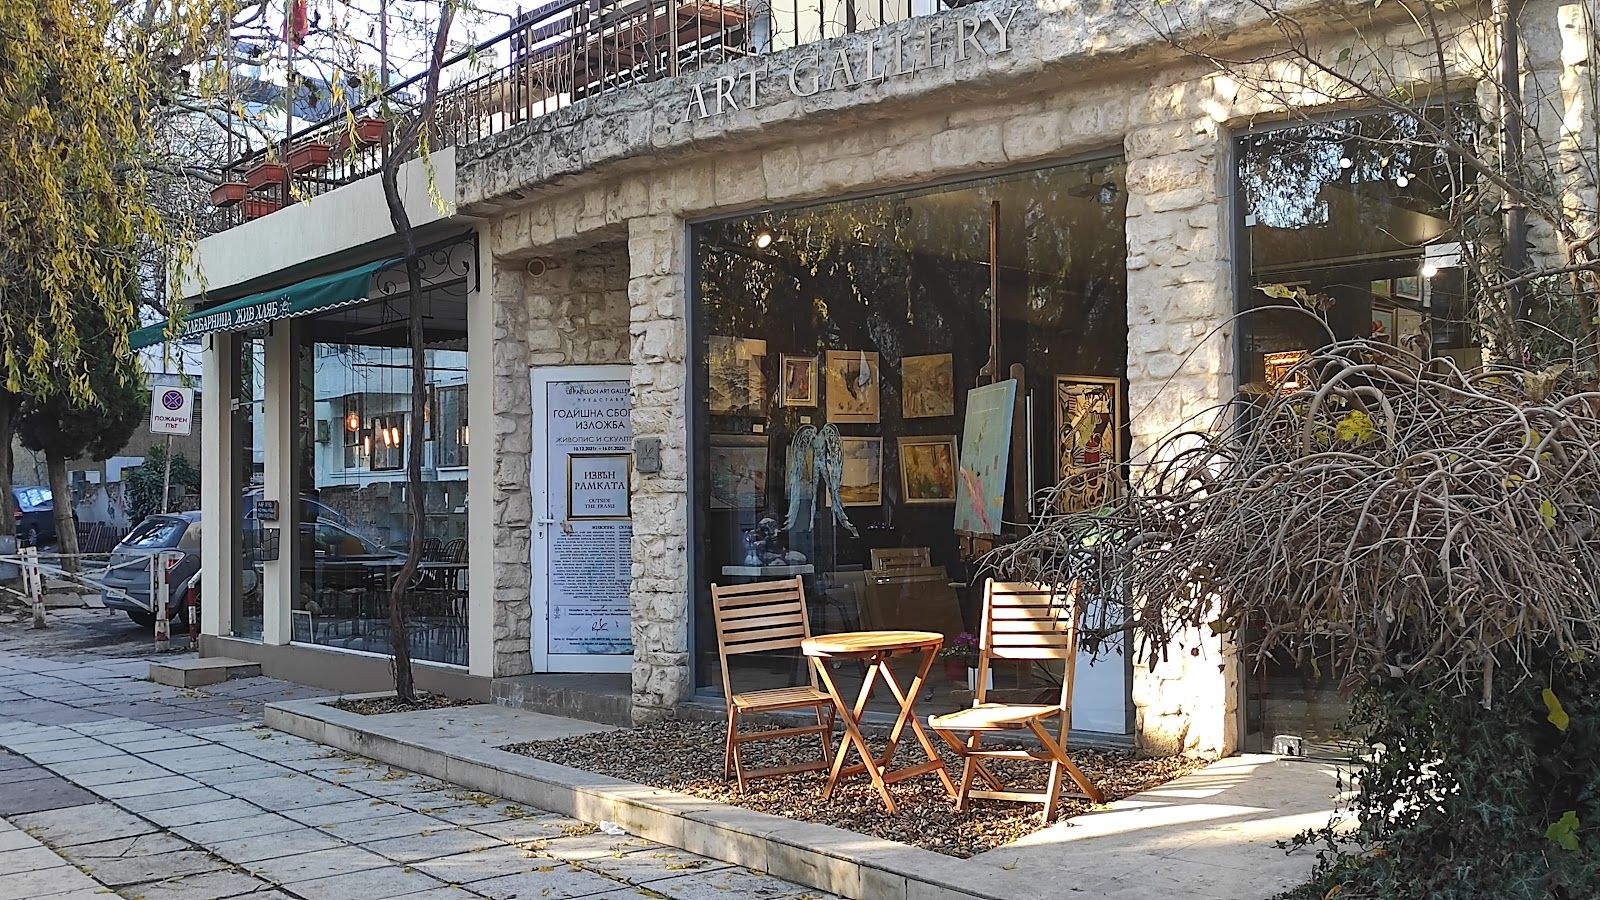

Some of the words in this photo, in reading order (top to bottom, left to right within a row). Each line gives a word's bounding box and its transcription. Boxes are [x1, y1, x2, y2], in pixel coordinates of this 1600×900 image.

[684, 62, 770, 122] ART
[788, 6, 1020, 98] GALLERY
[184, 312, 232, 334] ХЛЕБАРНИЦА
[235, 306, 255, 325] ЖИВ
[255, 301, 278, 320] ХЛЯБ
[553, 408, 604, 419] ГОДИШНА
[154, 415, 188, 423] ПОЖАРЕН
[575, 420, 625, 430] ИЗЛОЖБА
[584, 471, 616, 480] ИЗВЪН
[574, 481, 626, 490] РАМКАТА
